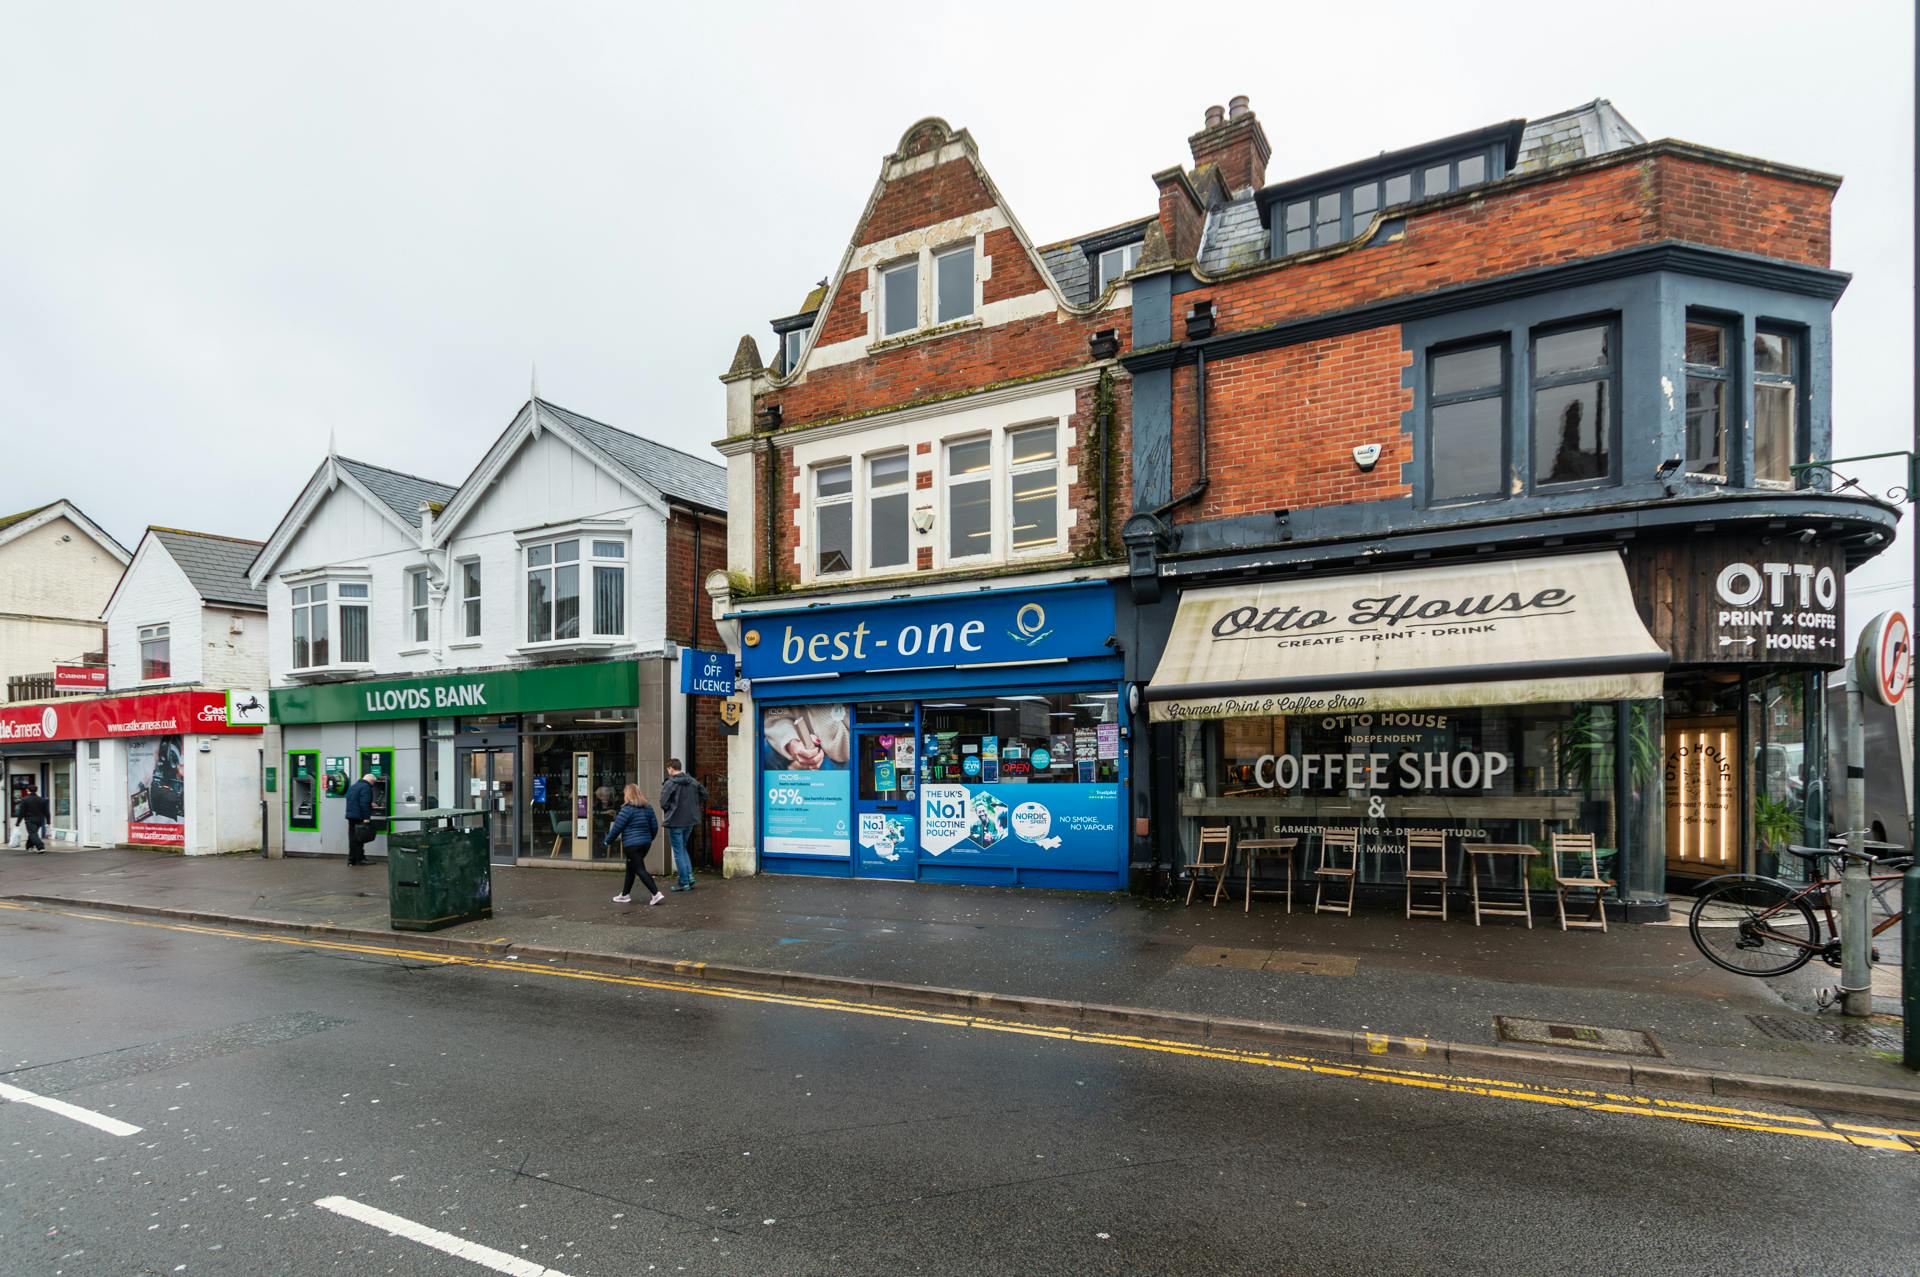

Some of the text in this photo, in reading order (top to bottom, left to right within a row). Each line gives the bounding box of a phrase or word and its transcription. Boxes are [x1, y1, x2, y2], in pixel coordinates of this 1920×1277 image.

[1716, 563, 1837, 610] OTTO
[1212, 588, 1576, 637] Otto House
[1719, 611, 1774, 626] PRINT
[1798, 612, 1836, 629] COFFEE
[1278, 624, 1497, 648] CREATE PRINT DRINK
[1766, 634, 1816, 650] HOUSE
[704, 665, 722, 677] OFF
[693, 678, 731, 692] LICENCE
[366, 683, 487, 712] LLOYDS BANK
[203, 705, 227, 715] Cast
[1168, 694, 1366, 719] Garment Print & Coffee Shop
[197, 711, 227, 722] Came
[1322, 714, 1447, 730] OTTO HOUSE
[1344, 734, 1422, 743] INDEPENDENT
[1002, 764, 1031, 772] OPEN
[1254, 752, 1508, 789] COFFEE SHOP
[1665, 744, 1731, 781] OTTO HOUSE
[768, 788, 804, 805] 95%
[926, 790, 963, 798] THE UK'S
[926, 800, 965, 818] No.1
[1367, 795, 1386, 819] &
[1015, 812, 1048, 820] NORDIC
[863, 820, 884, 830] No.1
[1273, 825, 1323, 835] GARMENT
[1442, 828, 1487, 838] STUDIO
[1366, 844, 1406, 854] MMXIX
